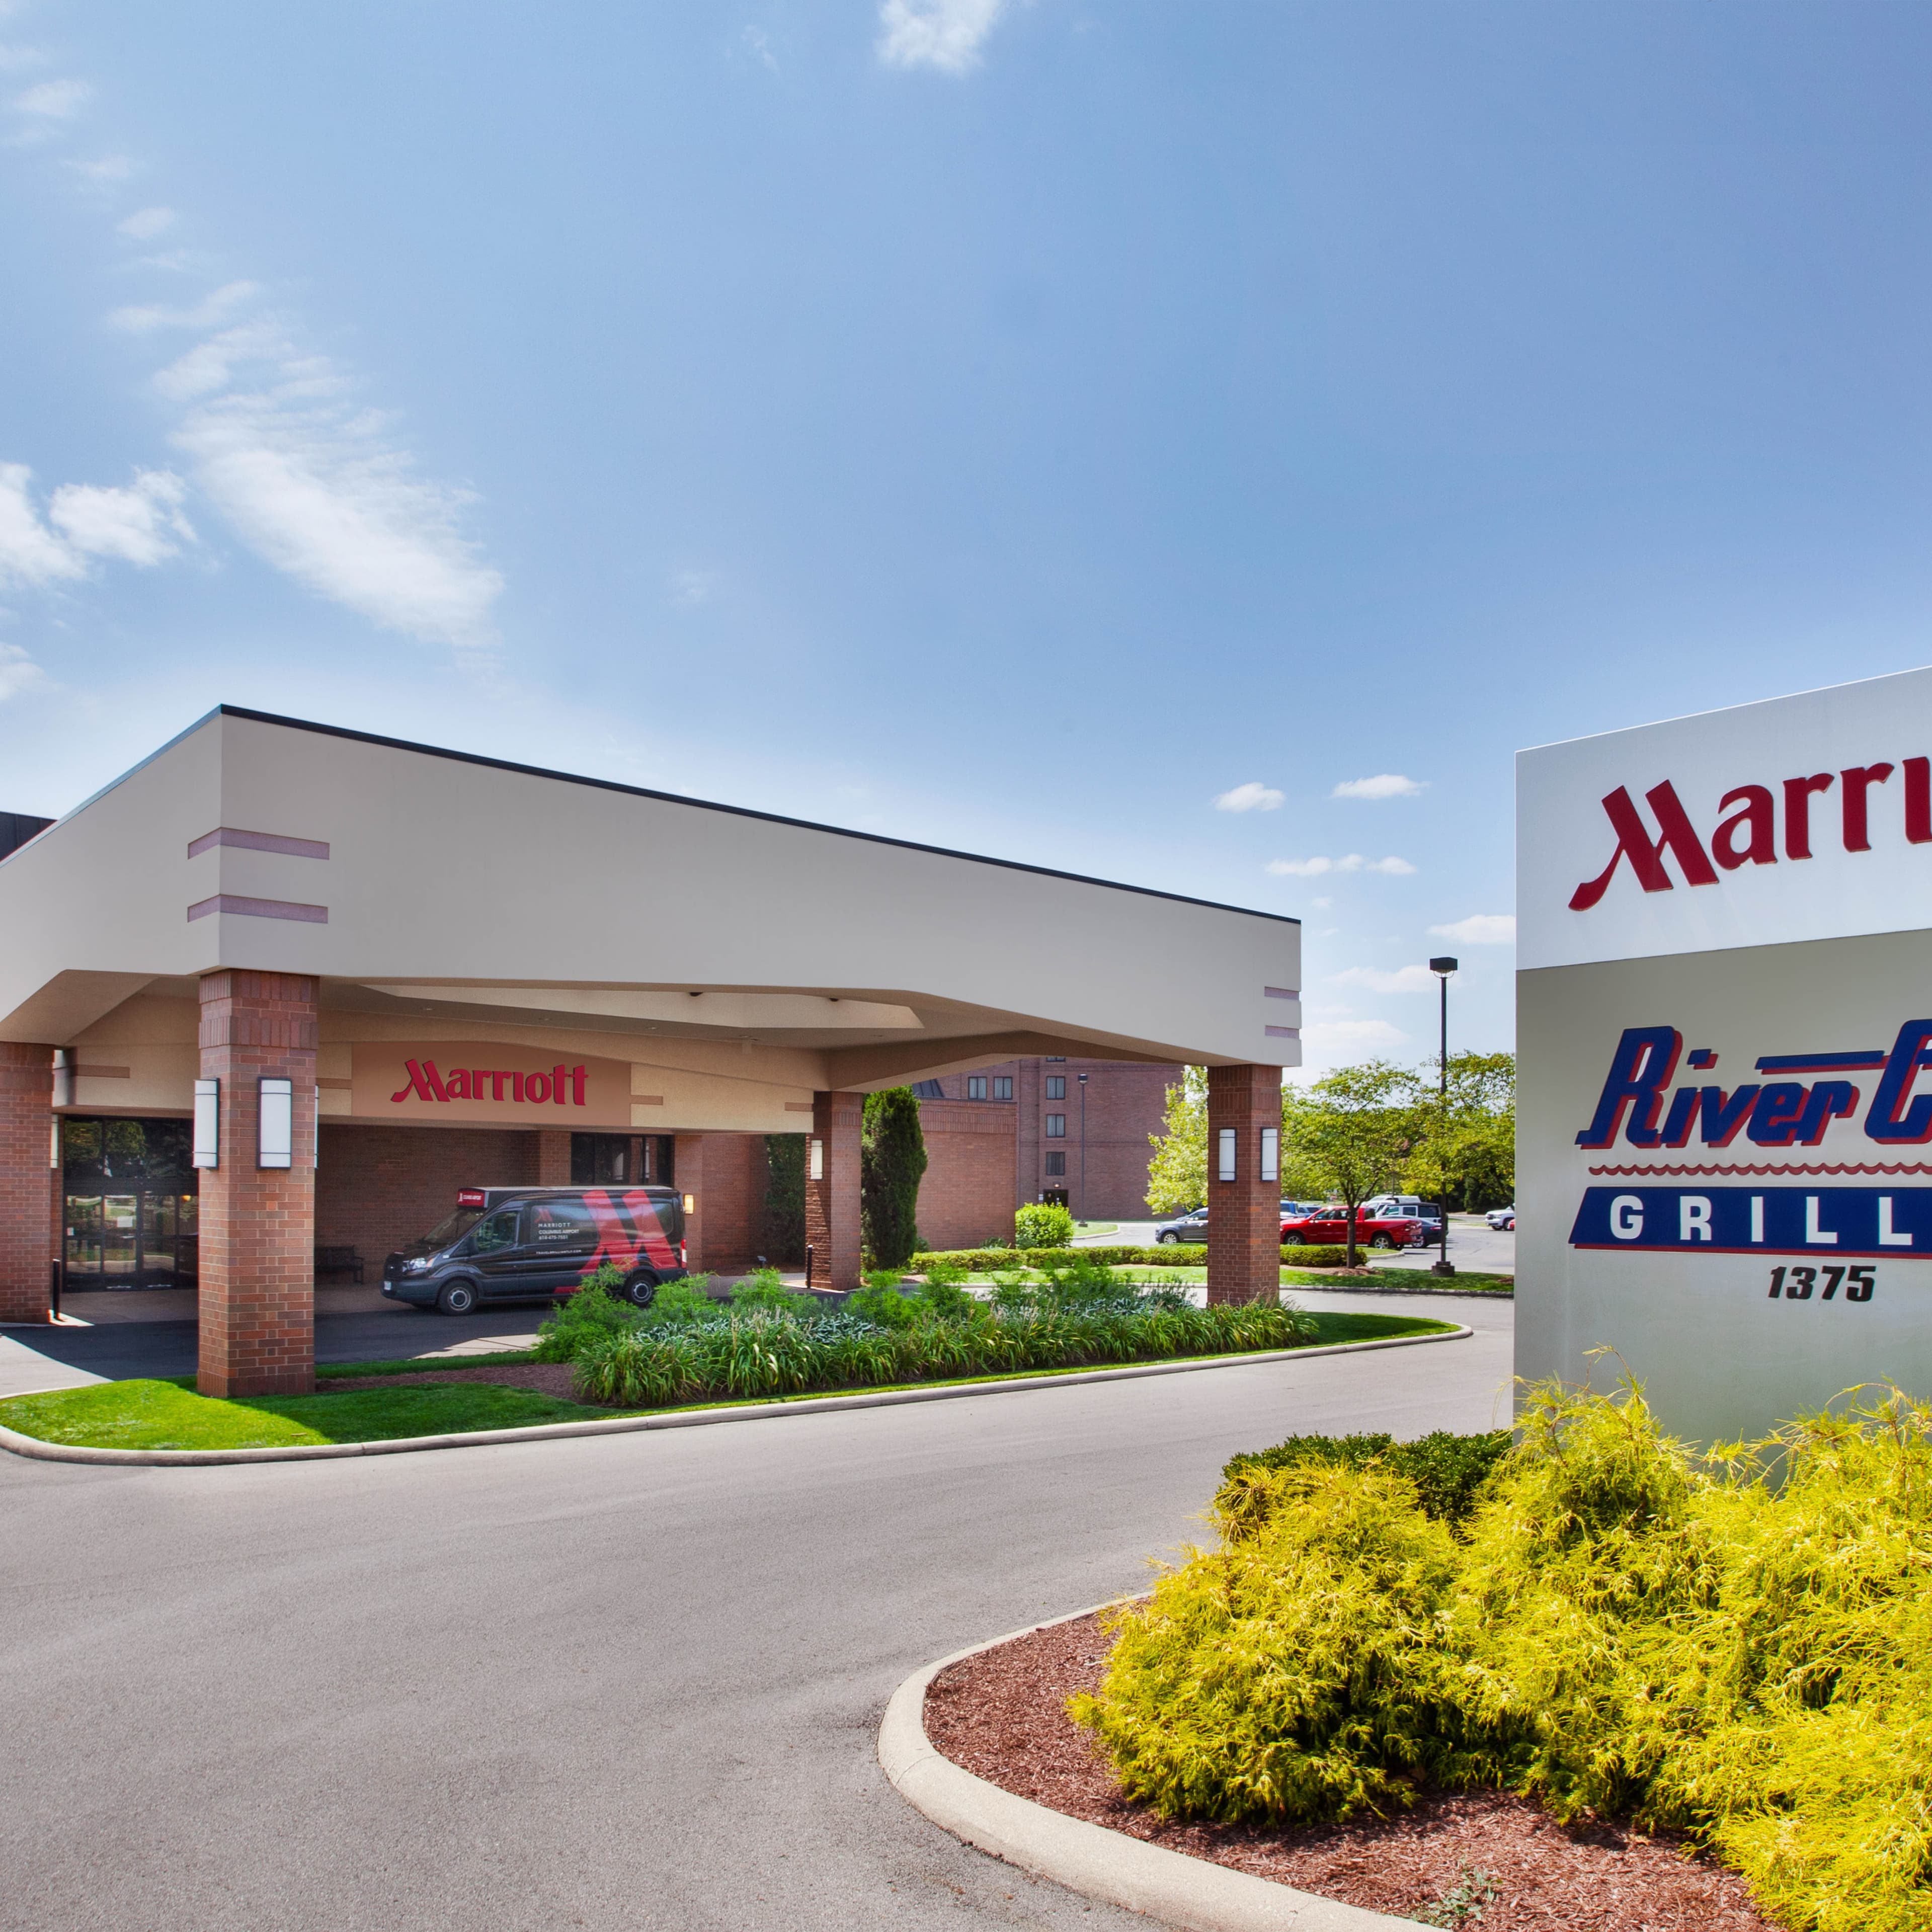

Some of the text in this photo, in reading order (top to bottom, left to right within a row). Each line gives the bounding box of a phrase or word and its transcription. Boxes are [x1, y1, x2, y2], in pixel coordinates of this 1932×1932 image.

[390, 1059, 589, 1106] Marriott
[1610, 1195, 1912, 1246] GRILL
[1768, 1265, 1876, 1302] 1375
